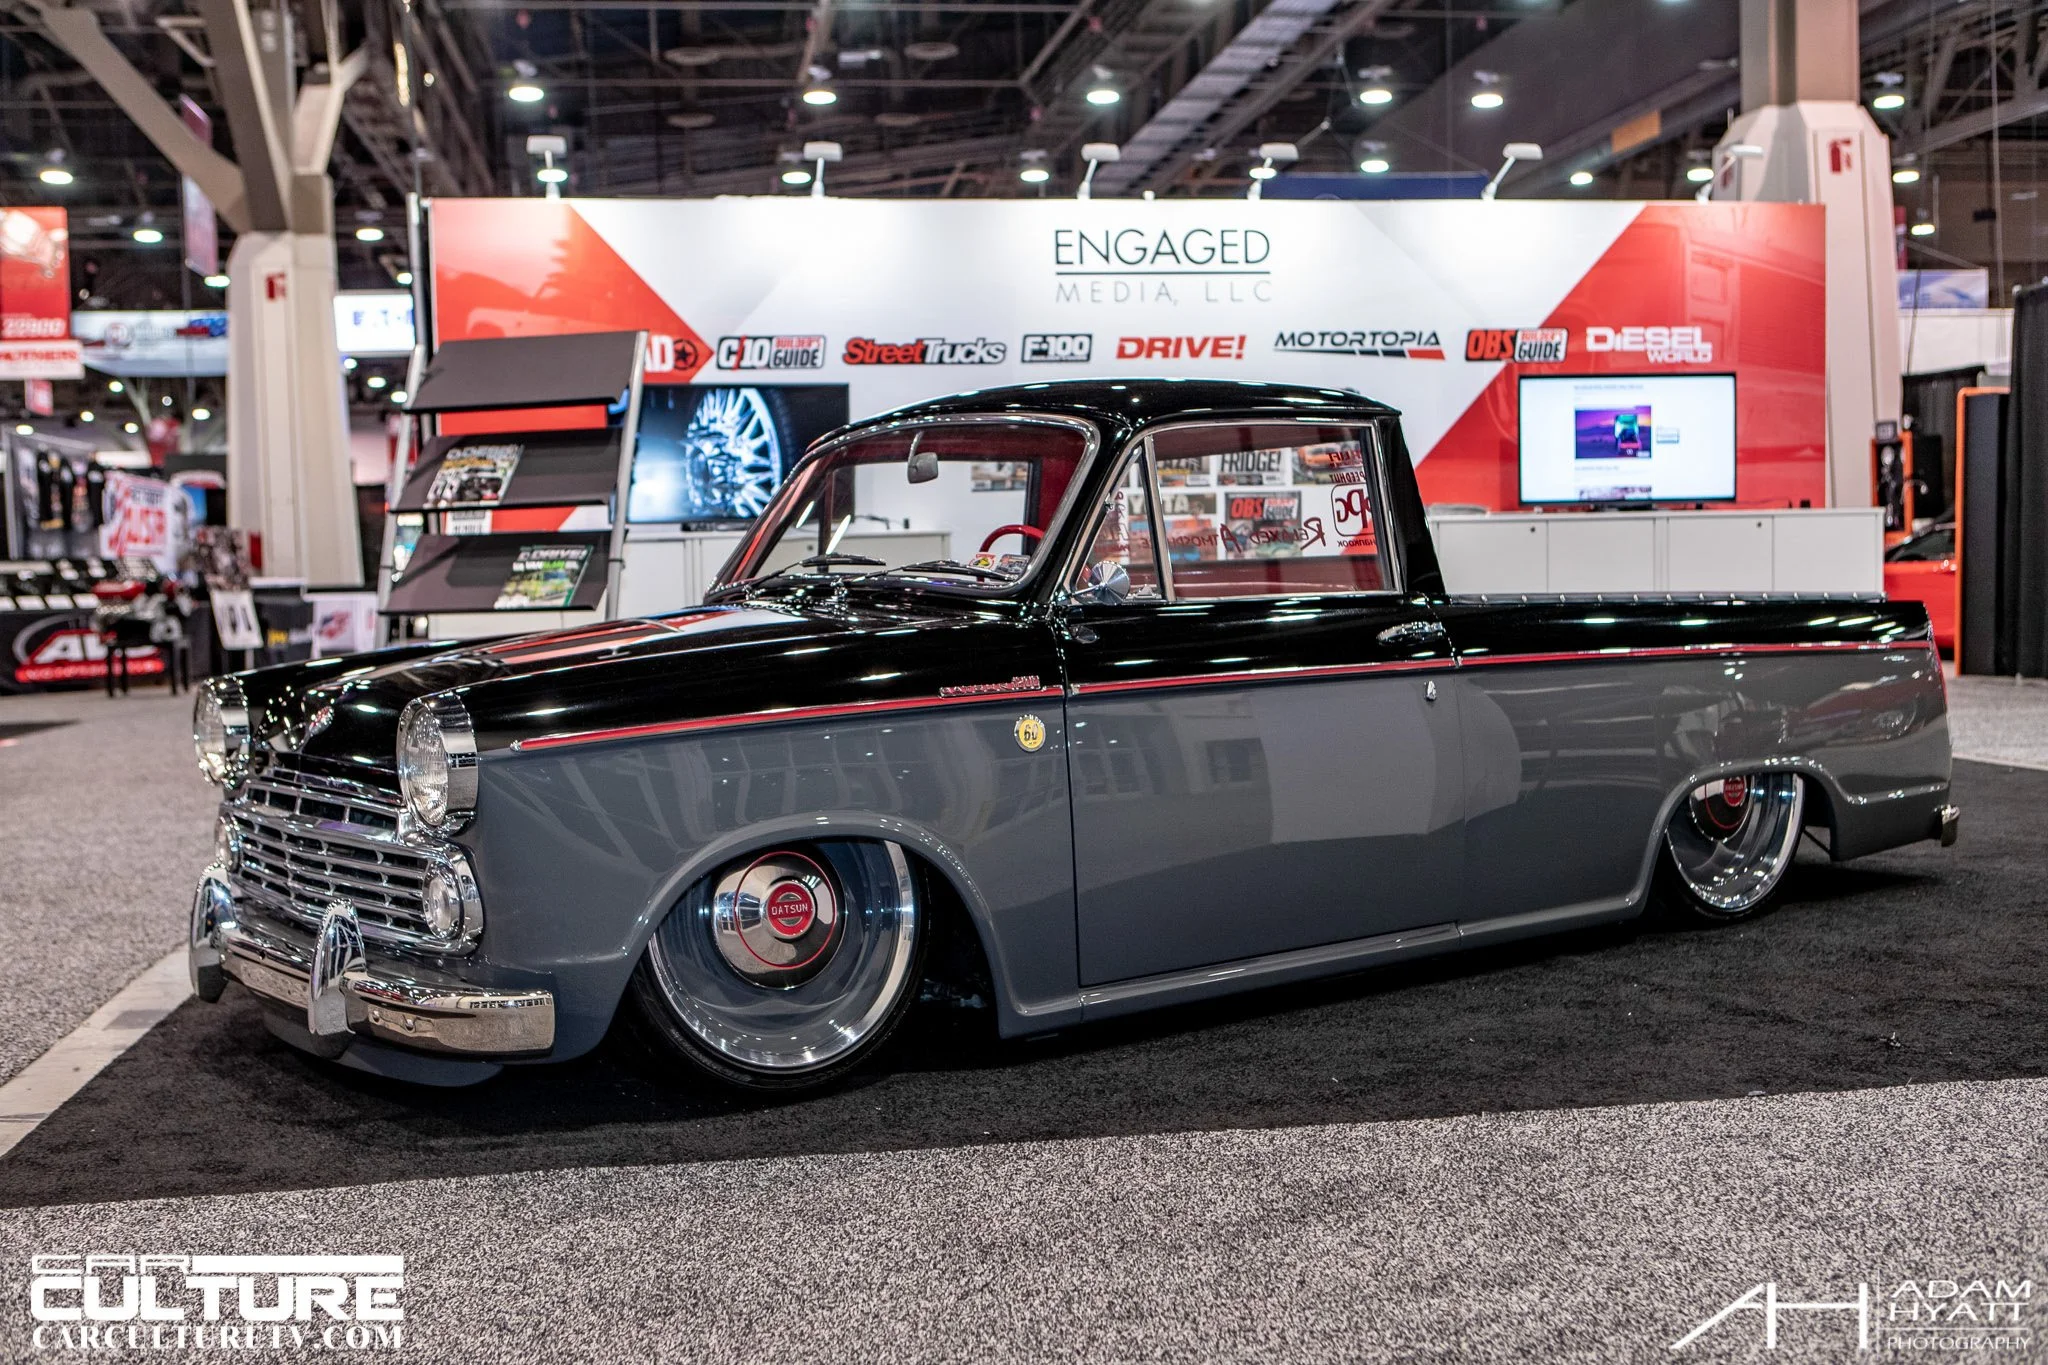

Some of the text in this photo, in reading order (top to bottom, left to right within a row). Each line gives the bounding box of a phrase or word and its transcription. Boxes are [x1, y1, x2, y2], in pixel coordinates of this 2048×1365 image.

[1055, 229, 1270, 265] ENGAGED
[1055, 280, 1273, 306] MEDIA, LLC
[1116, 335, 1247, 360] DRIVE!
[1274, 331, 1441, 348] MOTORTOPIA
[1467, 330, 1514, 360] OBS
[773, 348, 819, 367] GUIDE
[1518, 341, 1562, 361] GUIDE
[1647, 350, 1713, 363] WORLD
[1220, 451, 1282, 473] FRIDGE!
[1231, 497, 1264, 519] OBS
[771, 903, 808, 916] DATSUN
